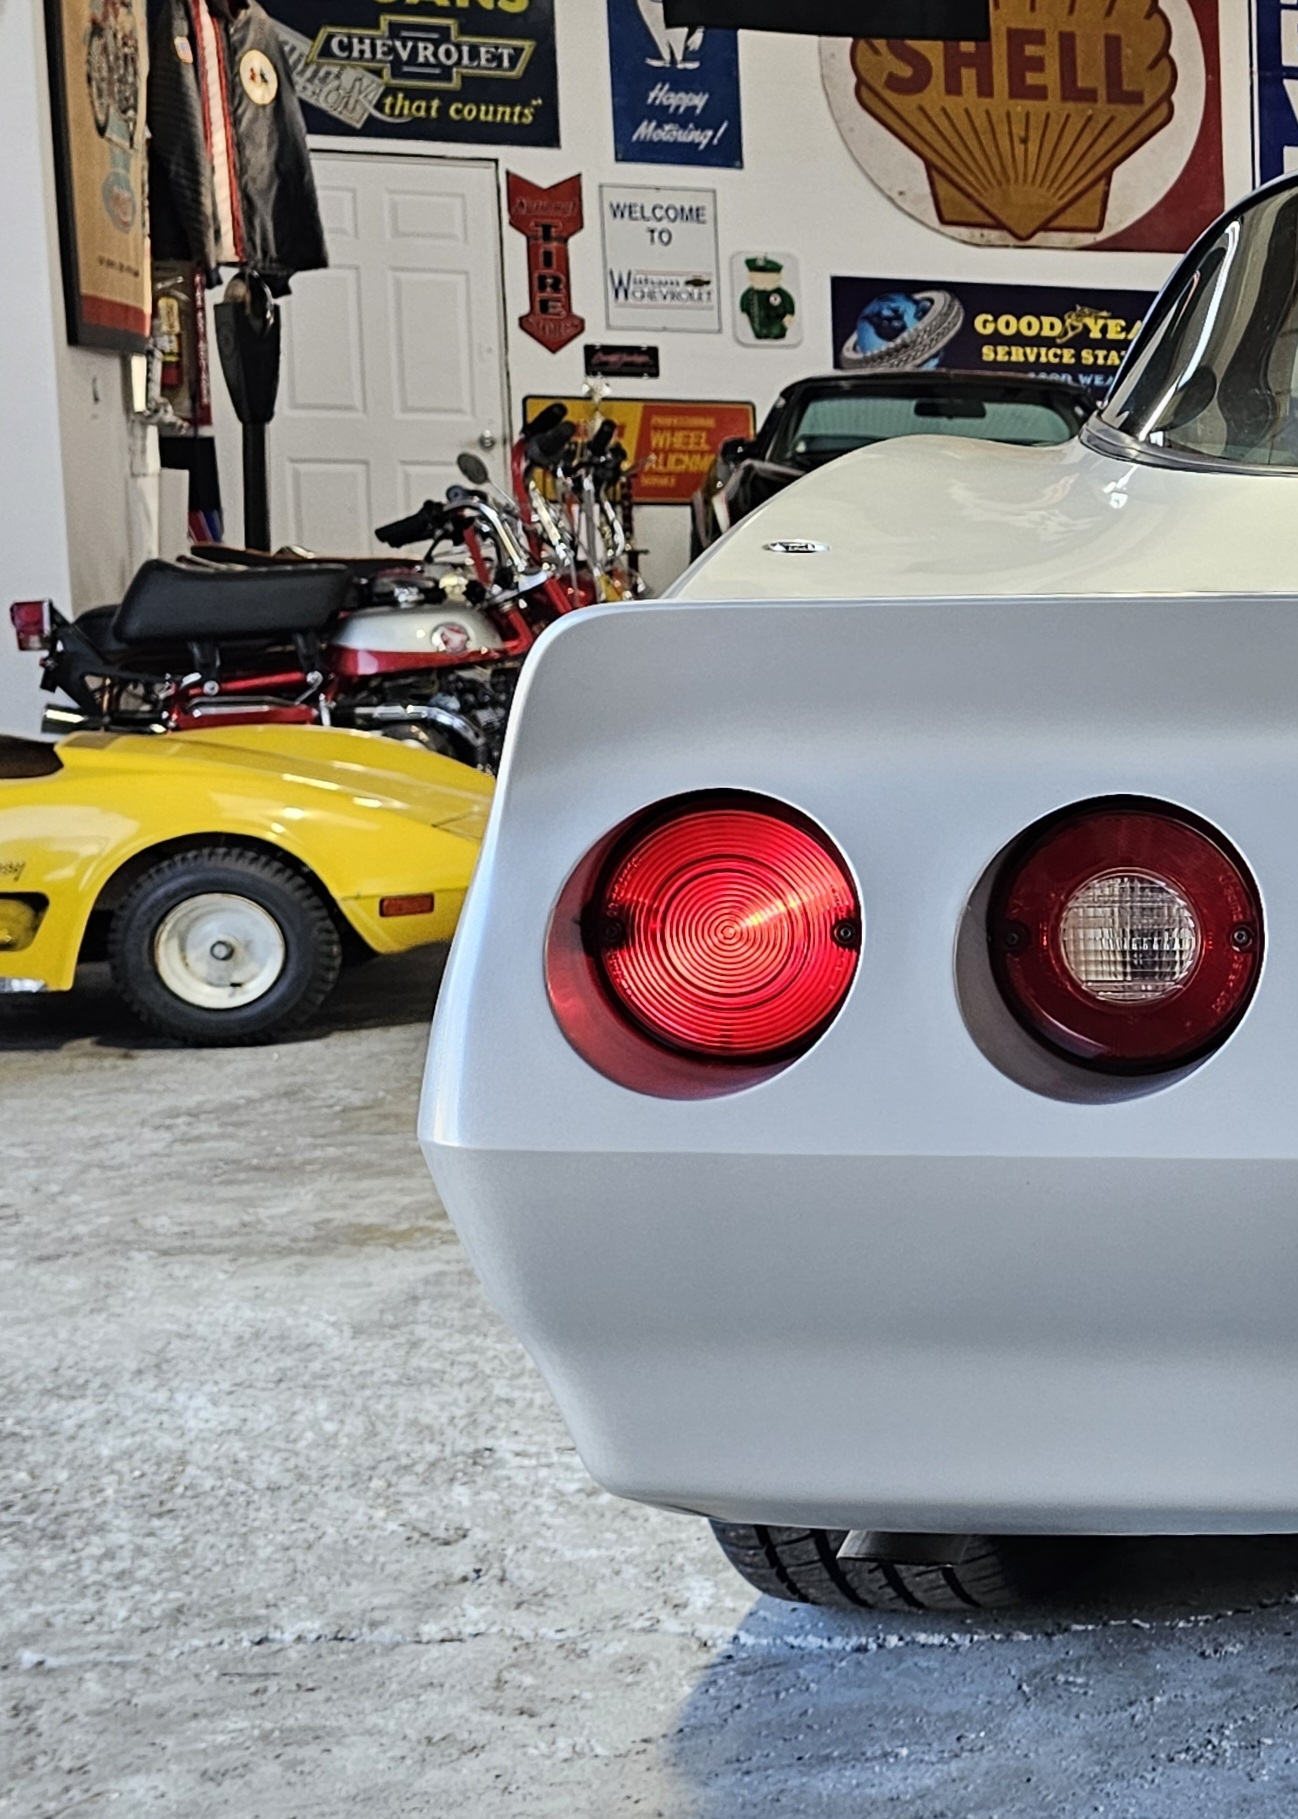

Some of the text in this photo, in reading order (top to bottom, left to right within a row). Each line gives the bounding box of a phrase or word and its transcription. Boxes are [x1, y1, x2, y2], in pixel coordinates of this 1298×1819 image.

[330, 33, 515, 69] CHEVROLET
[883, 27, 1145, 105] SHELL
[382, 92, 440, 119] that
[646, 82, 709, 115] Happy
[631, 120, 728, 151] Motoring!
[609, 202, 706, 224] WELCOME
[647, 227, 672, 245] TO
[530, 219, 566, 318] TIRE
[981, 345, 1076, 365] SERVICE
[651, 429, 711, 451] WHEEL
